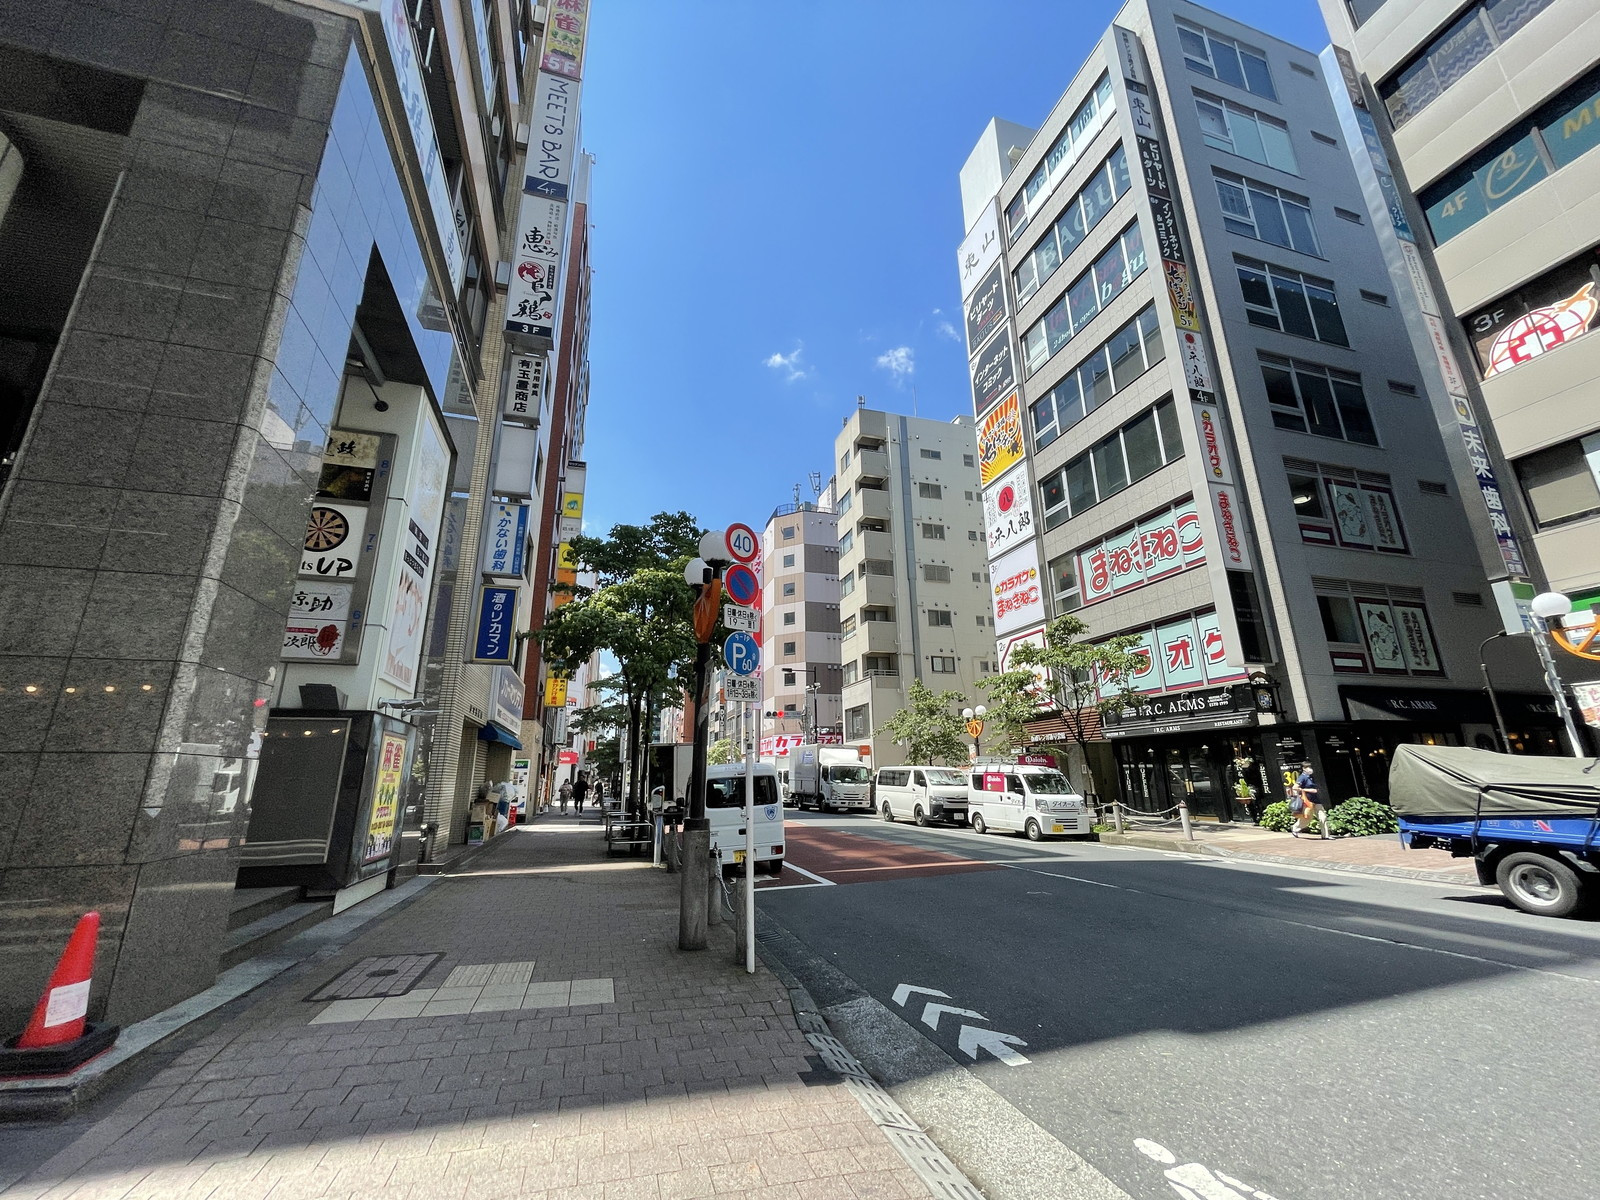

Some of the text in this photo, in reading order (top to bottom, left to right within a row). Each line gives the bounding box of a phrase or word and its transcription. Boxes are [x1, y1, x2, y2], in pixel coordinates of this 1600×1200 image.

[545, 78, 569, 136] MEETS
[539, 139, 562, 179] BAR
[1149, 143, 1166, 190] ビリヤード
[537, 181, 557, 196] 4F
[1040, 152, 1129, 274] BAGUS
[1441, 192, 1467, 218] 4F
[522, 226, 559, 258] 恵み
[1161, 202, 1181, 260] インターネット
[970, 280, 999, 322] ビリヤード
[976, 297, 995, 326] ダーツ
[521, 323, 541, 335] 3F
[1180, 314, 1193, 327] 5F
[1474, 308, 1506, 334] 3F
[531, 361, 542, 397] 事務用家具
[974, 344, 1009, 386] インターネット
[982, 366, 1003, 394] コミック
[1196, 390, 1209, 403] 4F
[1201, 418, 1222, 468] カラオケ
[1463, 429, 1512, 538] 未来歯科
[1217, 490, 1242, 564] まねきねこ
[366, 533, 377, 552] 7F
[491, 517, 512, 572] かない歯科
[733, 533, 751, 553] 40
[1089, 511, 1206, 596] まねきねこ
[316, 556, 353, 576] UP
[999, 567, 1031, 594] カラオケ
[995, 585, 1041, 620] まねきねこ
[351, 610, 362, 630] 6F
[487, 592, 507, 656] 酒のリカマン
[735, 633, 751, 643] 9-19
[732, 642, 747, 670] P
[742, 659, 753, 672] 60
[1168, 697, 1206, 714] ARMS
[1052, 800, 1077, 808] ダイオーズ
